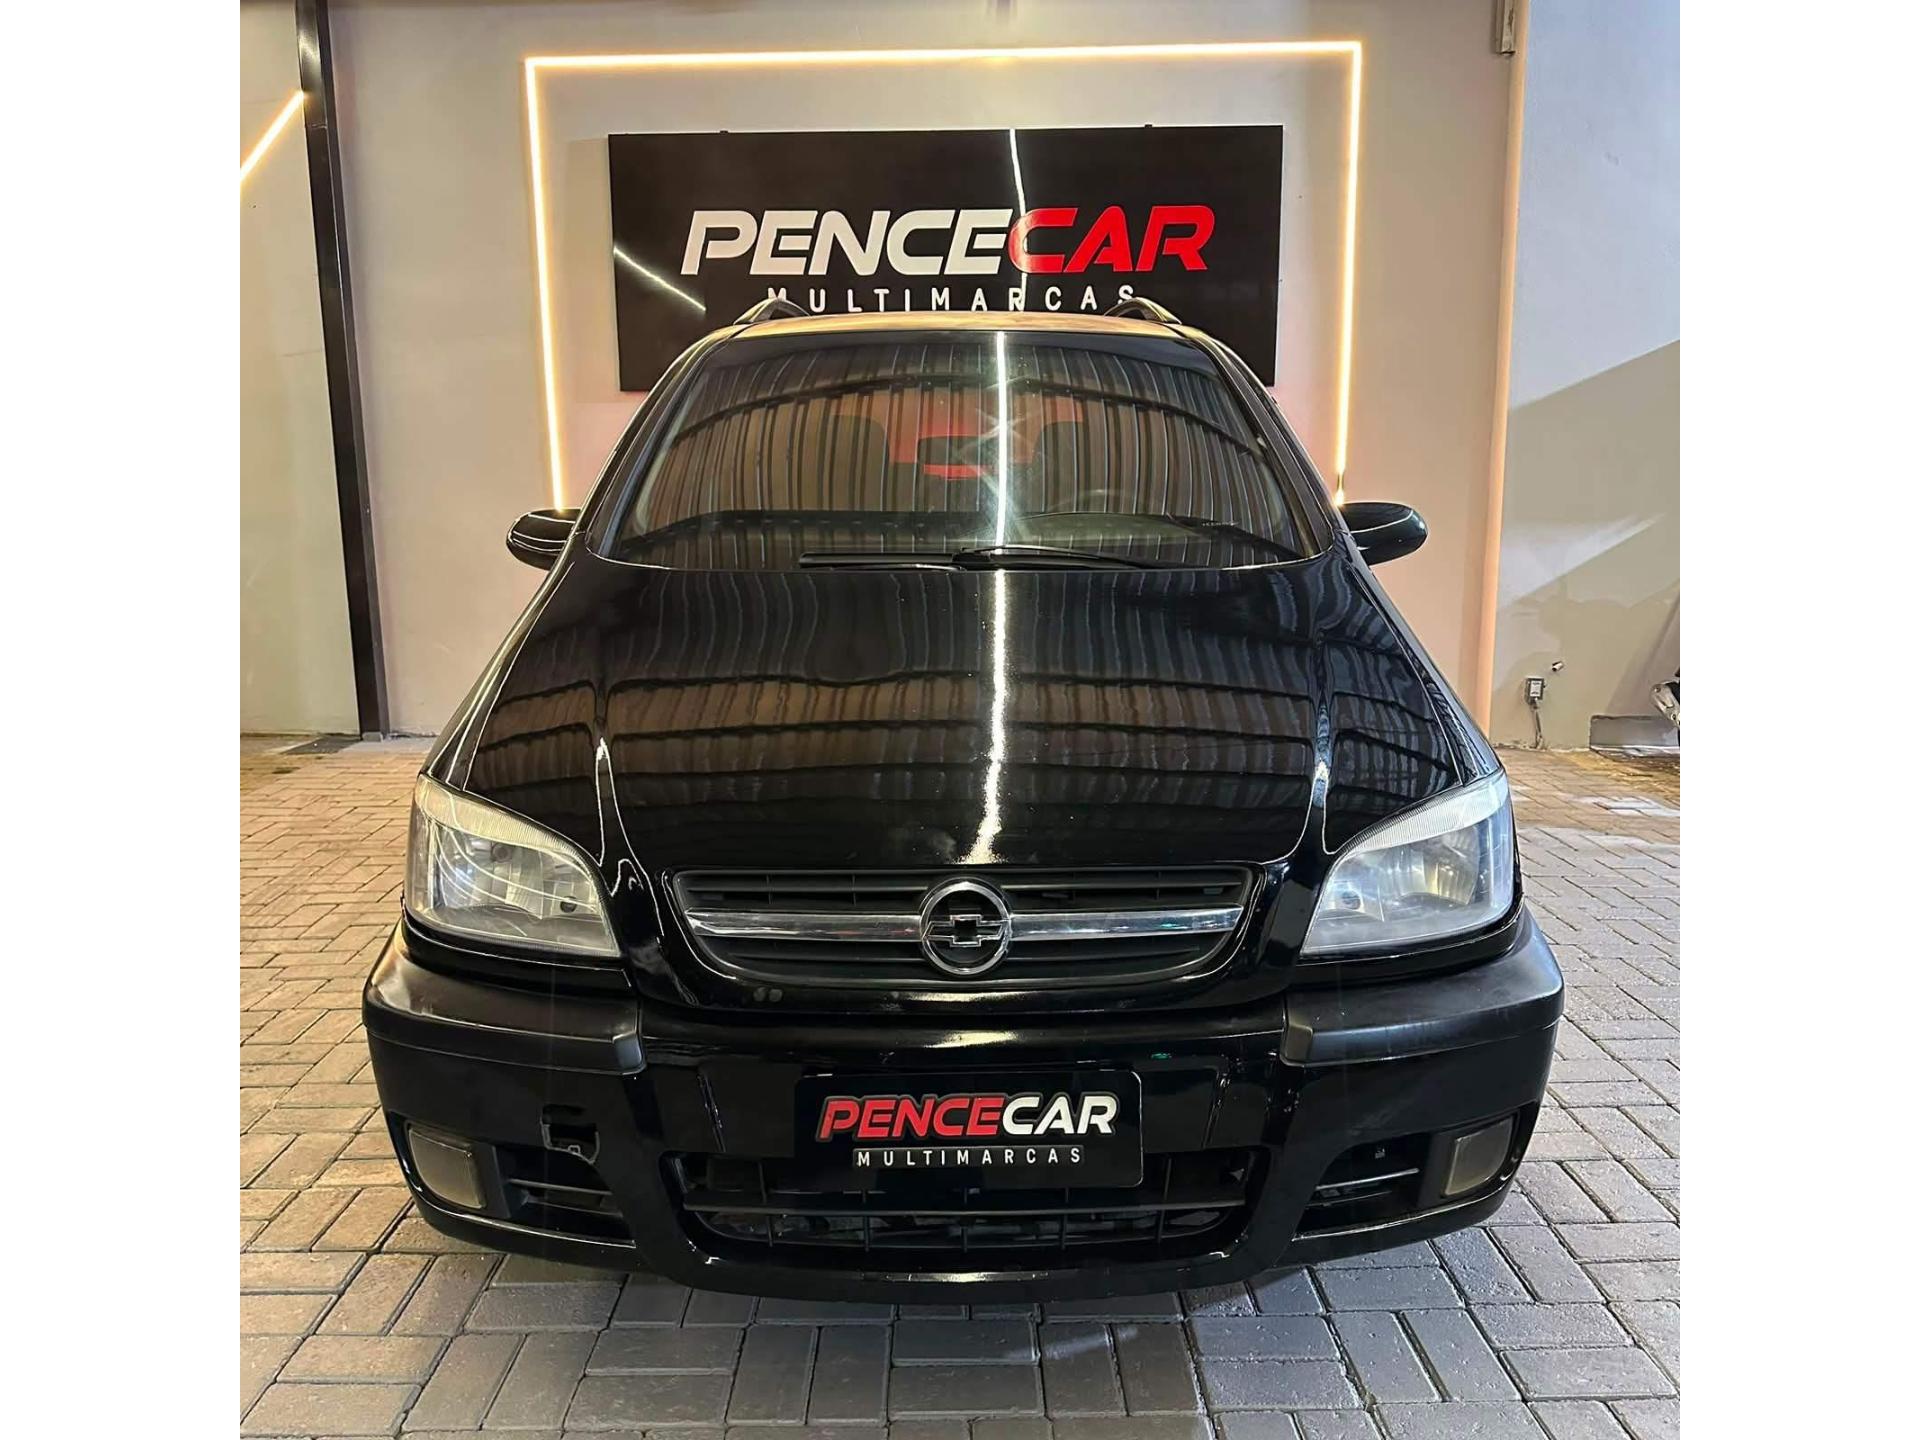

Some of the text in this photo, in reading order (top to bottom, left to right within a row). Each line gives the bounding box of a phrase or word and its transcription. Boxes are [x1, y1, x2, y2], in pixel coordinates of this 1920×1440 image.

[680, 204, 1216, 276] PENCECAR
[818, 1094, 1119, 1139] PENCECAR
[857, 1147, 1082, 1167] MULTIMARCAS
